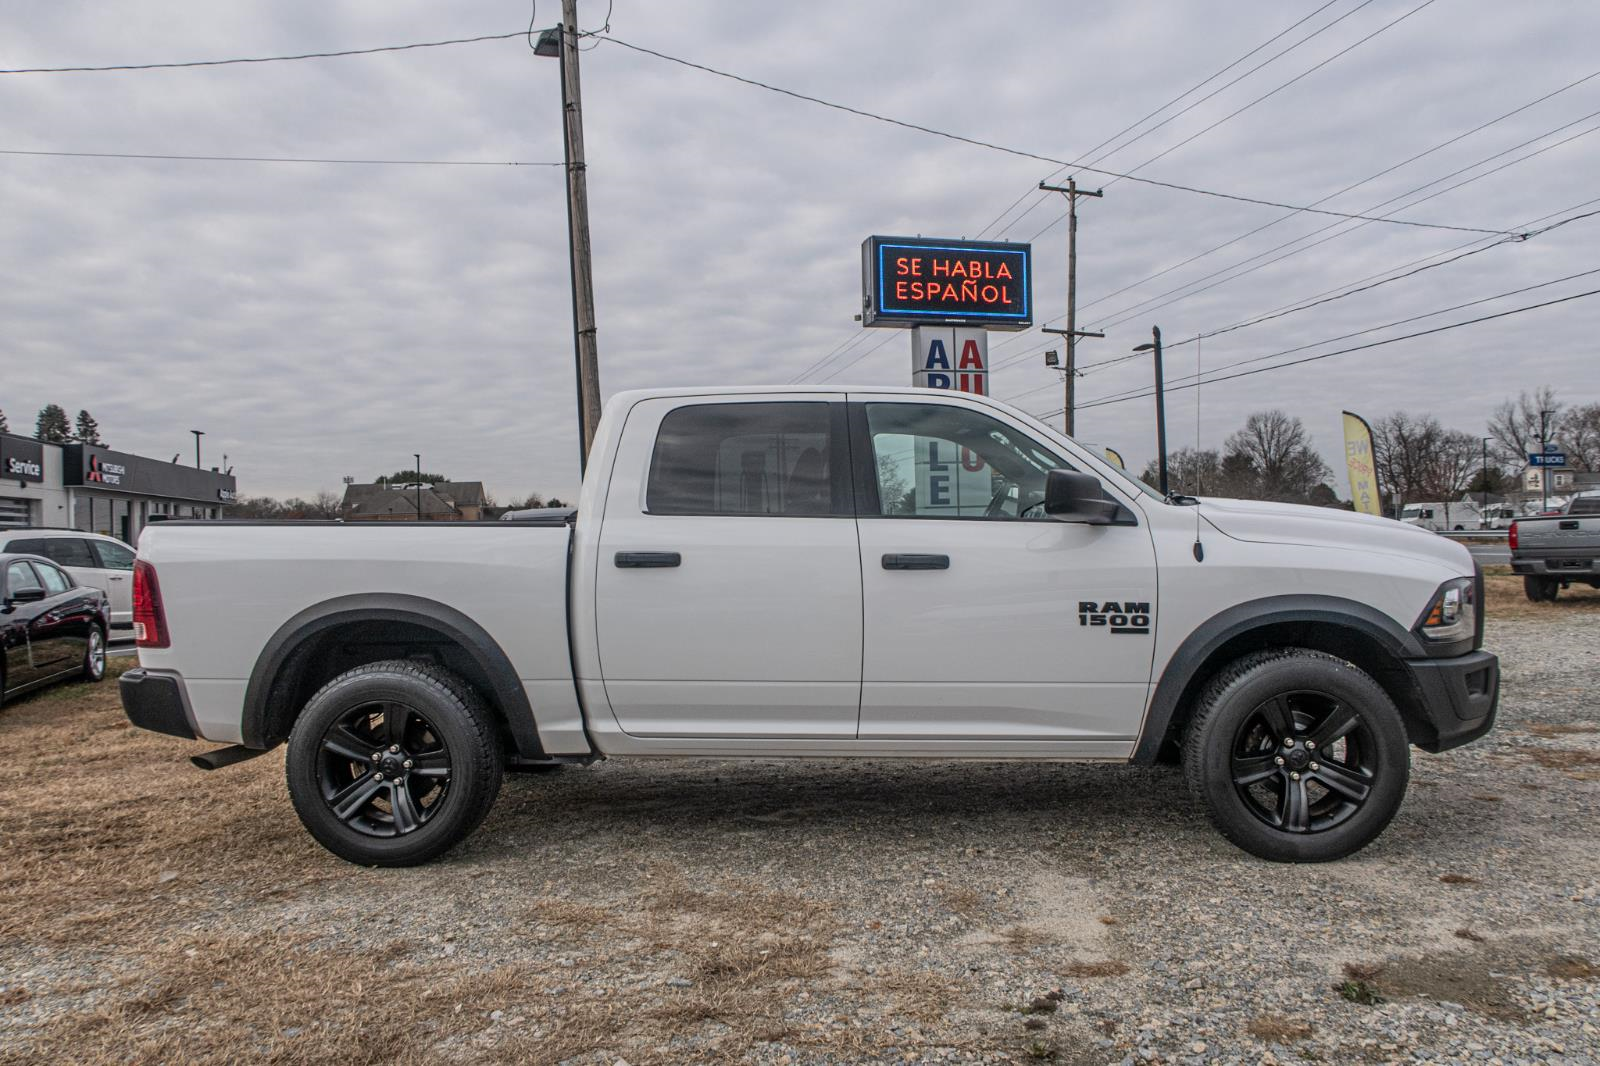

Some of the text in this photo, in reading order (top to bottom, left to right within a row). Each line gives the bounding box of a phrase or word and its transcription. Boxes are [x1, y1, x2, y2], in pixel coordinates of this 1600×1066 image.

[897, 258, 1012, 279] SE HABLA
[896, 280, 1012, 304] ESPAÑOL
[9, 458, 40, 476] Service
[1078, 602, 1150, 614] RAM
[1079, 614, 1149, 626] 1500
